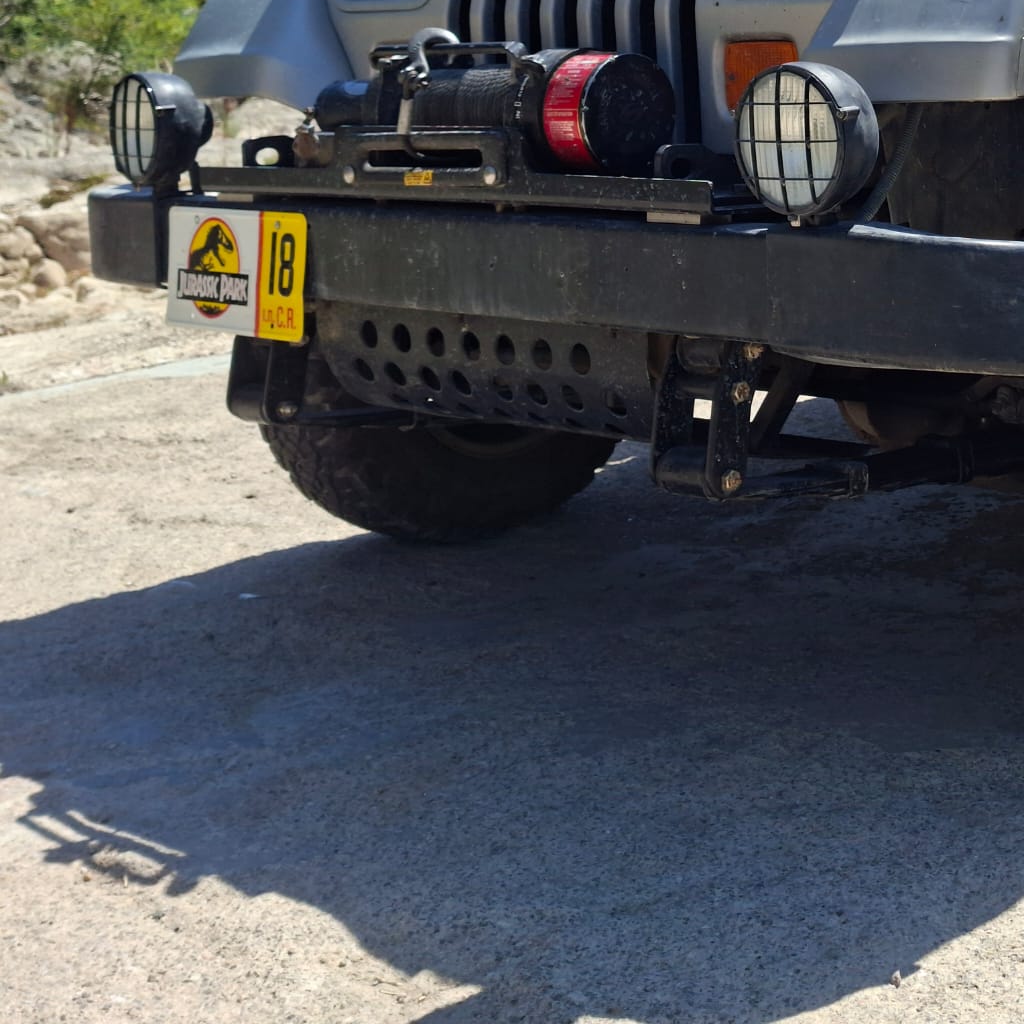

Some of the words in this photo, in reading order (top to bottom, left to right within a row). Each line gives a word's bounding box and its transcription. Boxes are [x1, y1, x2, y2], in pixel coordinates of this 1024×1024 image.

[177, 270, 219, 299] JURASSIC
[219, 273, 248, 302] PARK
[268, 231, 296, 297] 18
